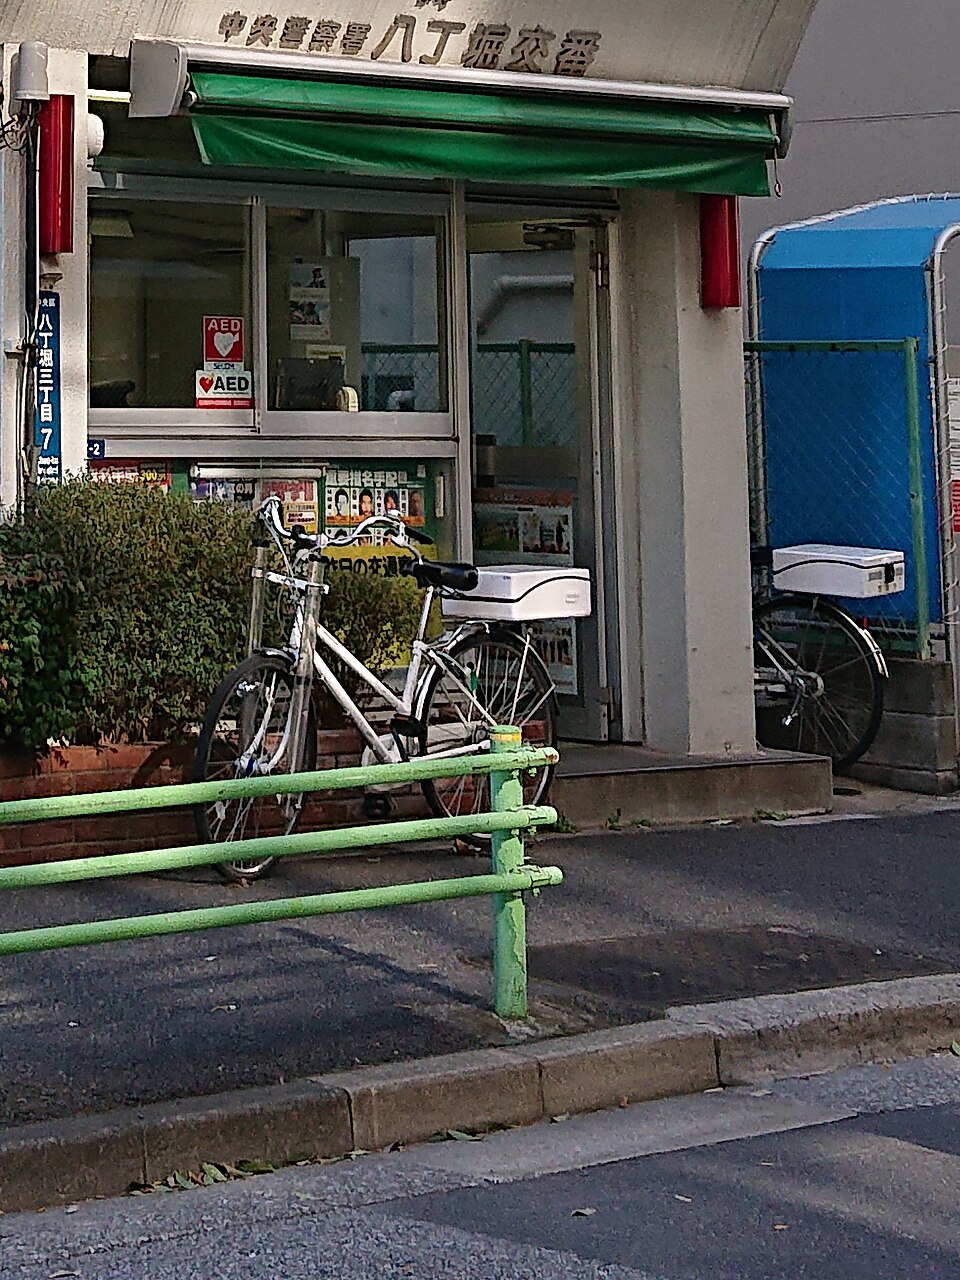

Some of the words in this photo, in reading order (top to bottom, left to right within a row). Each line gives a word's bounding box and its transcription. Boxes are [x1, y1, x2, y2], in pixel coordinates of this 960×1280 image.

[218, 11, 372, 56] 中央警察署
[370, 13, 603, 78] 八丁堀交番
[39, 297, 56, 307] 央区
[207, 318, 241, 332] AED
[214, 375, 250, 392] AED
